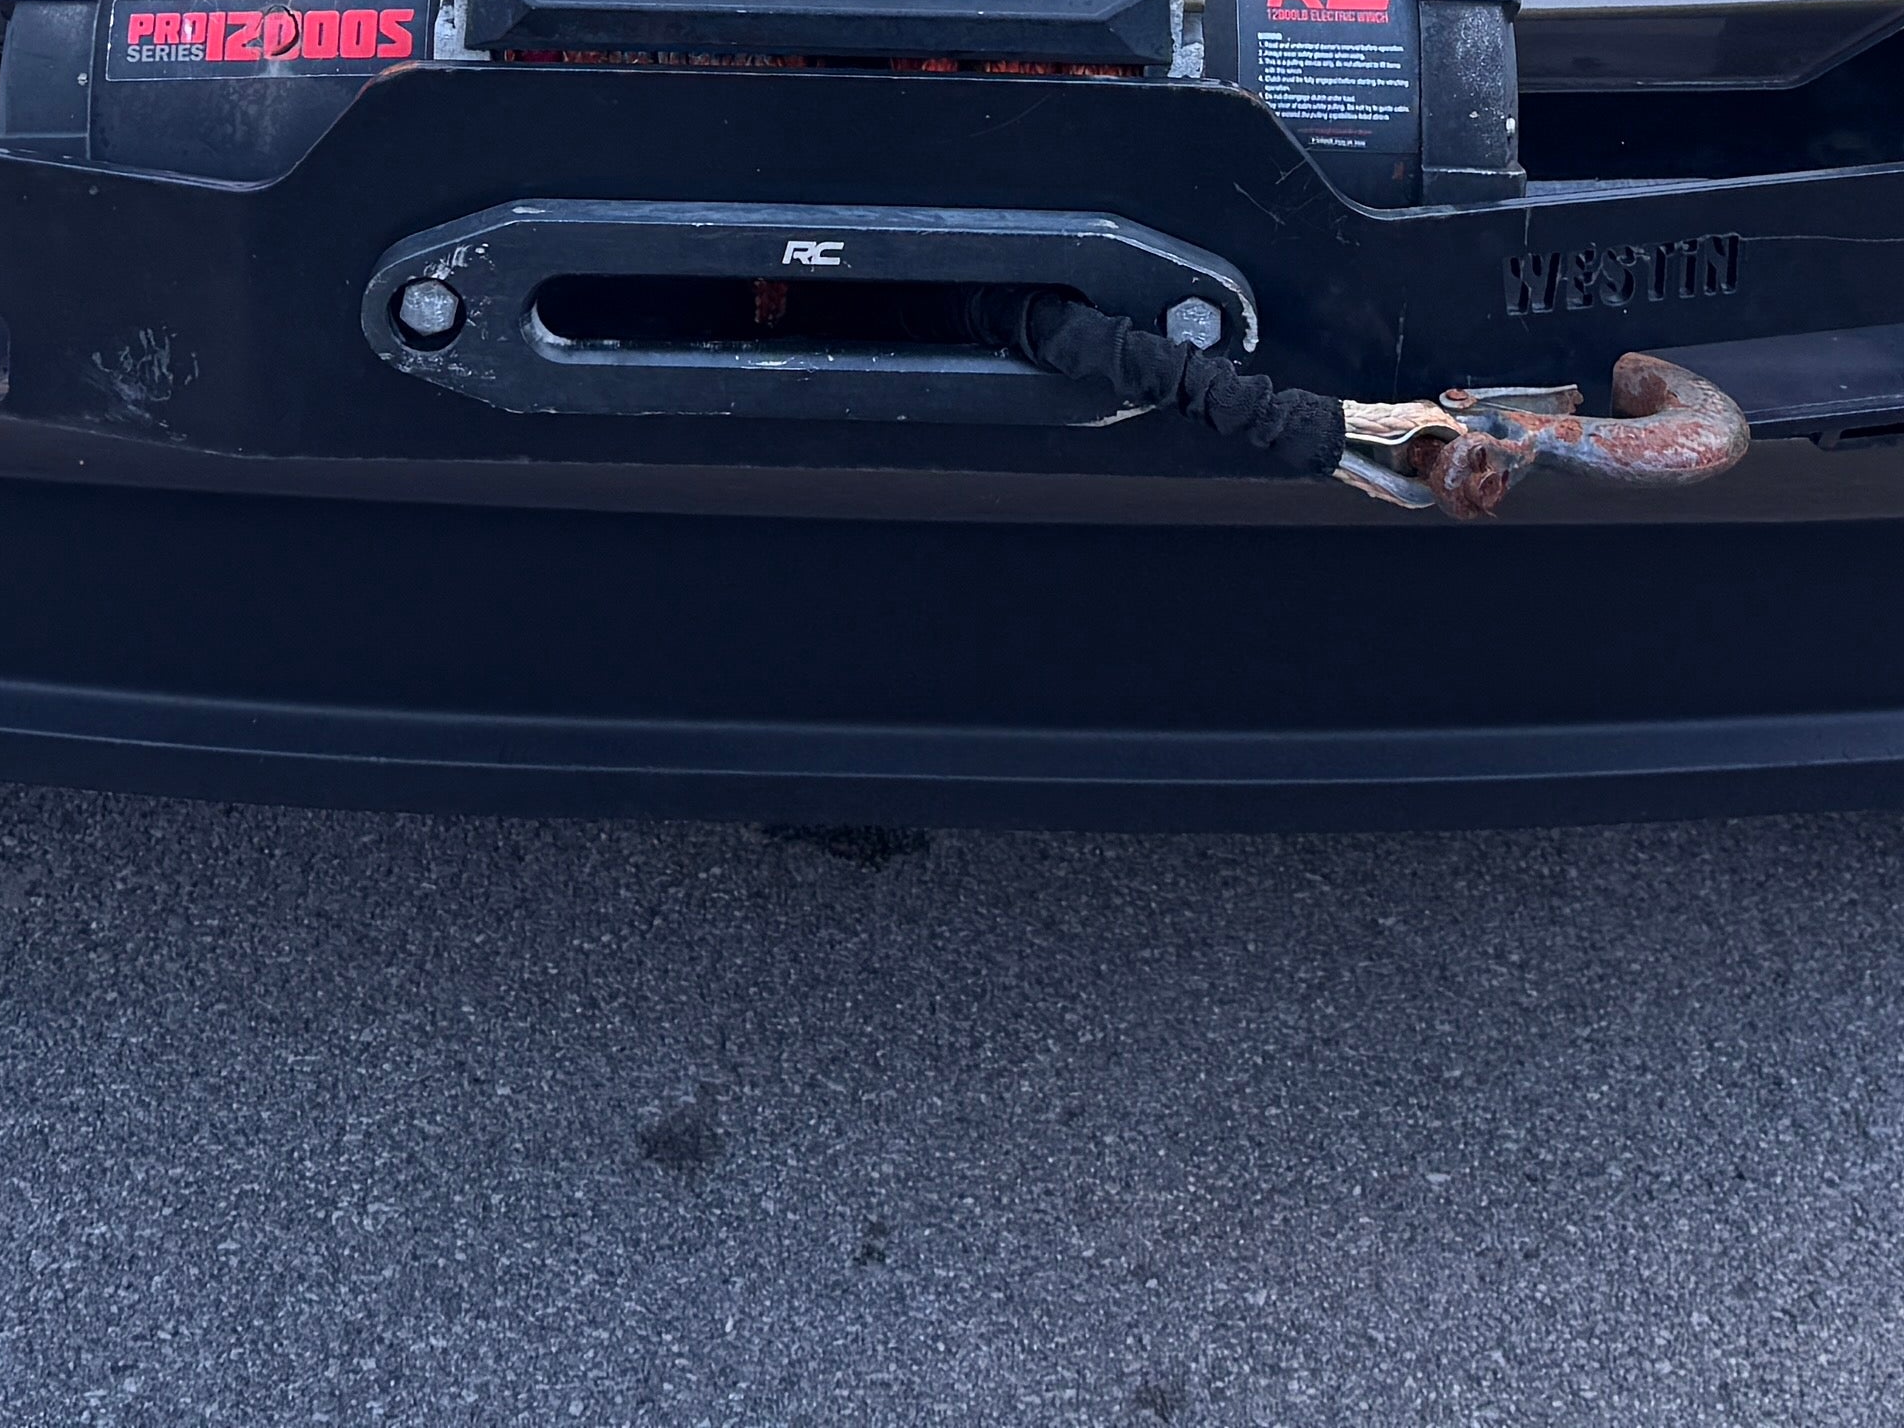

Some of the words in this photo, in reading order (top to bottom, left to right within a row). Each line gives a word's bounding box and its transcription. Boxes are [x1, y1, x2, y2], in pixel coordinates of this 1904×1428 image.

[127, 11, 209, 45] PRO
[1310, 10, 1356, 23] ELECTRIC
[125, 43, 207, 63] SERIES
[781, 240, 845, 266] RC
[1501, 233, 1740, 316] WESTIN
